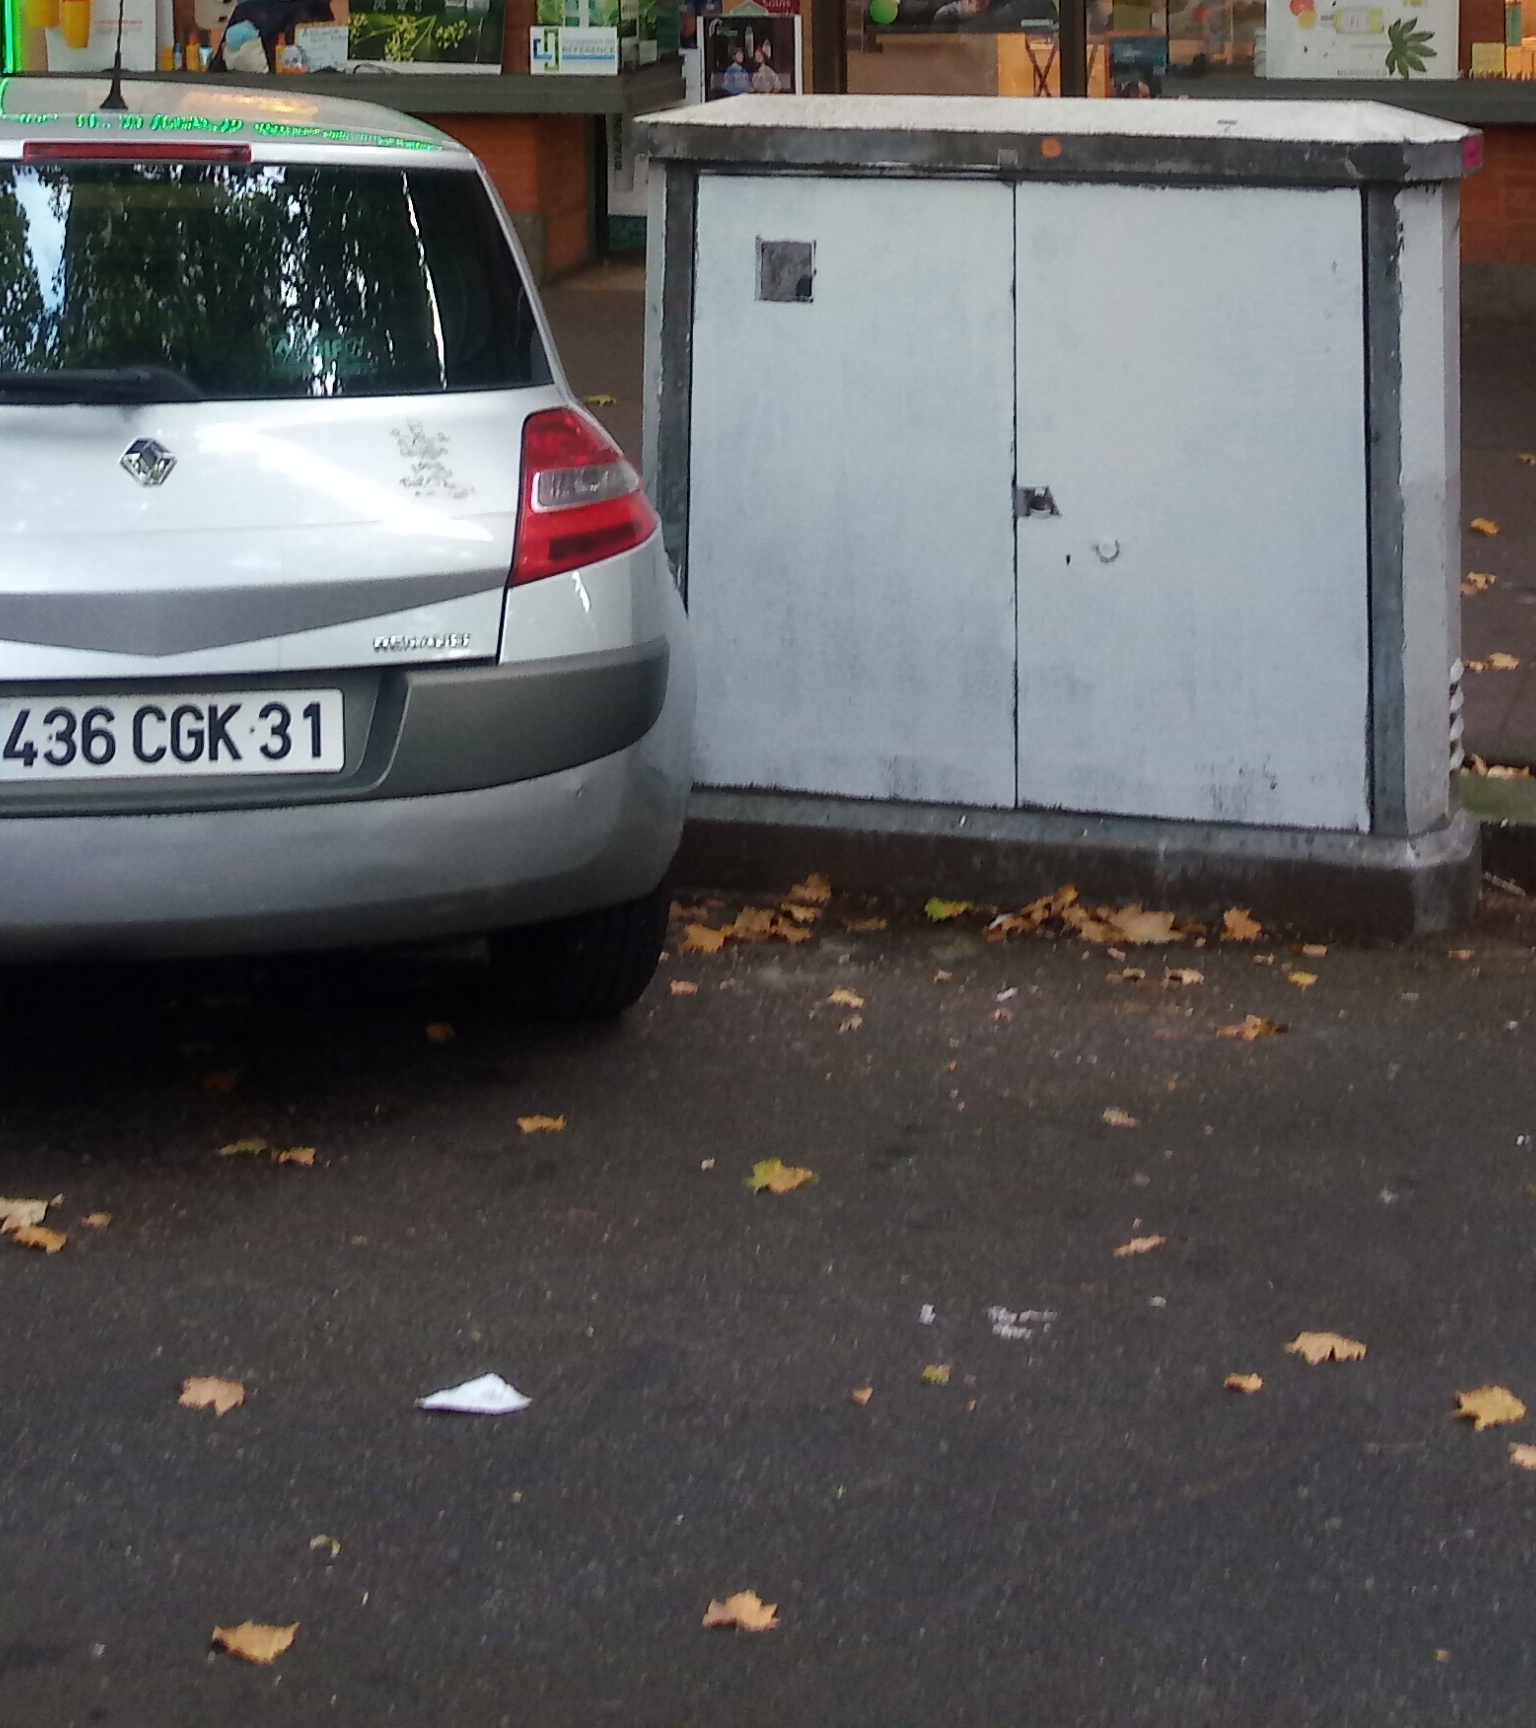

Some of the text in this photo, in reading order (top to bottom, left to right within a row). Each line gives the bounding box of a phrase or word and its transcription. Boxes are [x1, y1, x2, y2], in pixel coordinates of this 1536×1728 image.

[1, 700, 323, 768] 436 CGK 31
